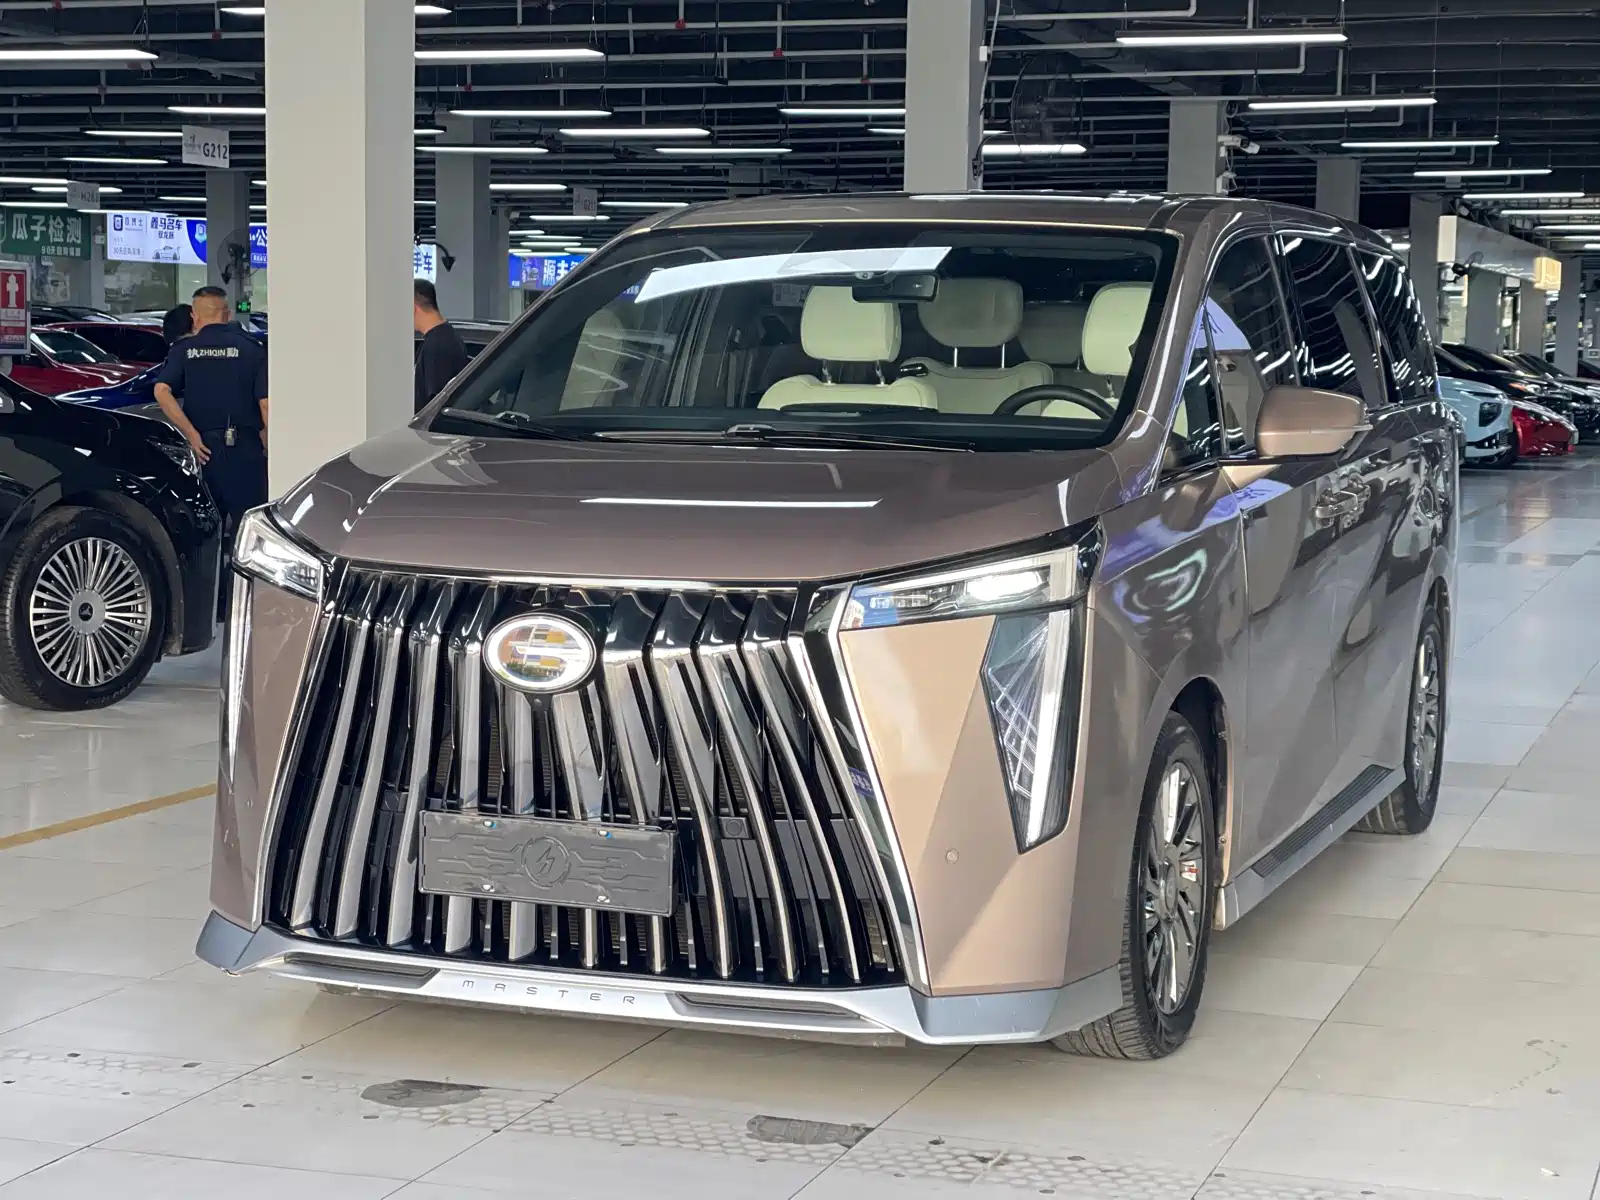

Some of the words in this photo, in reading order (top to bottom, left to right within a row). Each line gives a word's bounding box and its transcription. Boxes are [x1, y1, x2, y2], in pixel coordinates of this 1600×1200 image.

[202, 142, 228, 160] G212
[12, 212, 82, 244] 瓜子检测
[200, 348, 226, 357] ZHIQIN
[462, 979, 635, 1004] MASTER
